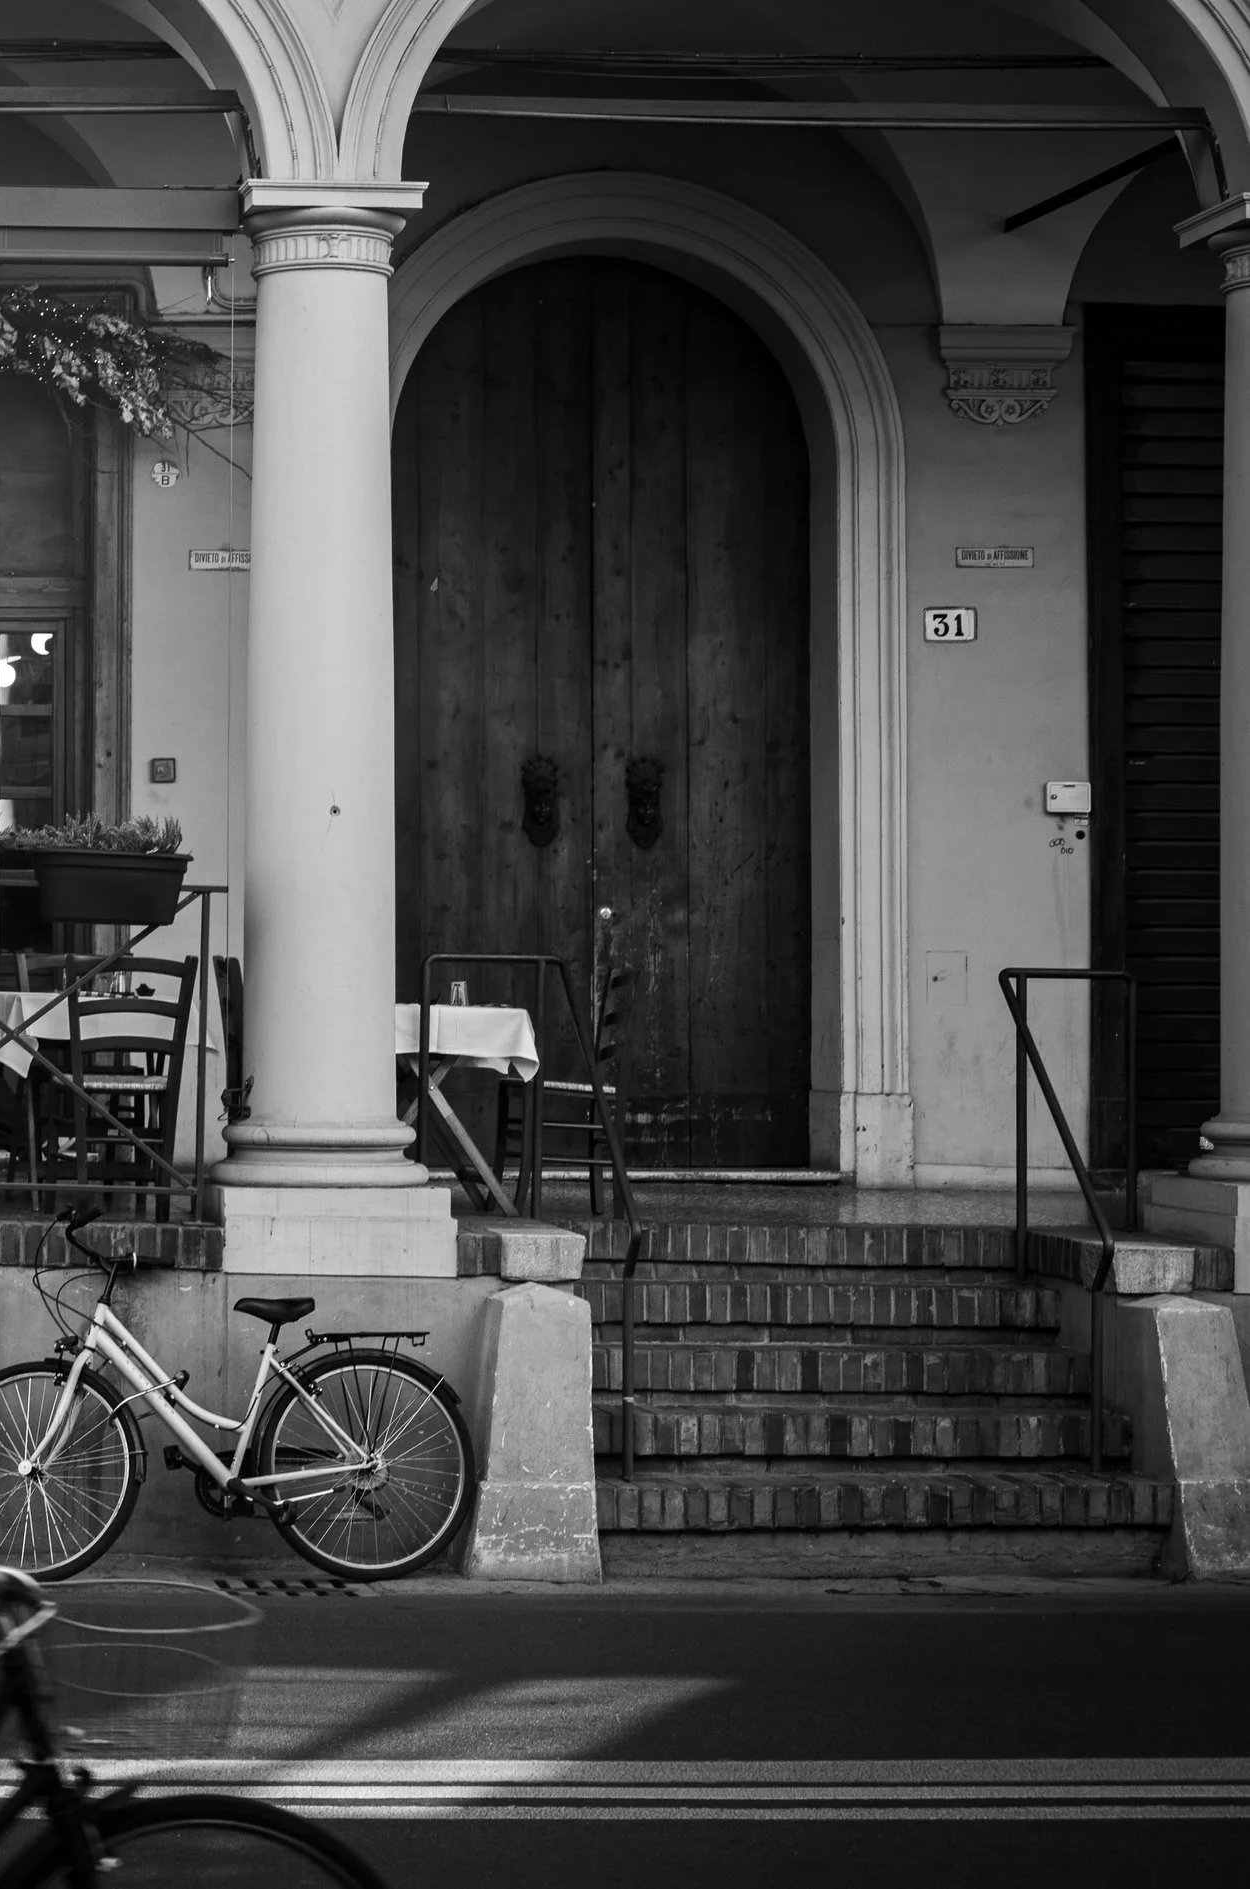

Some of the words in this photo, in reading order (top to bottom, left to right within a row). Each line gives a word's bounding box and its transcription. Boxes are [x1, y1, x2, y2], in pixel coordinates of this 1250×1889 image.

[162, 476, 169, 485] B
[194, 552, 219, 563] DIVIETO
[961, 550, 985, 561] DIVIETO
[994, 550, 1029, 561] AFFISSIONE
[933, 613, 964, 638] 31
